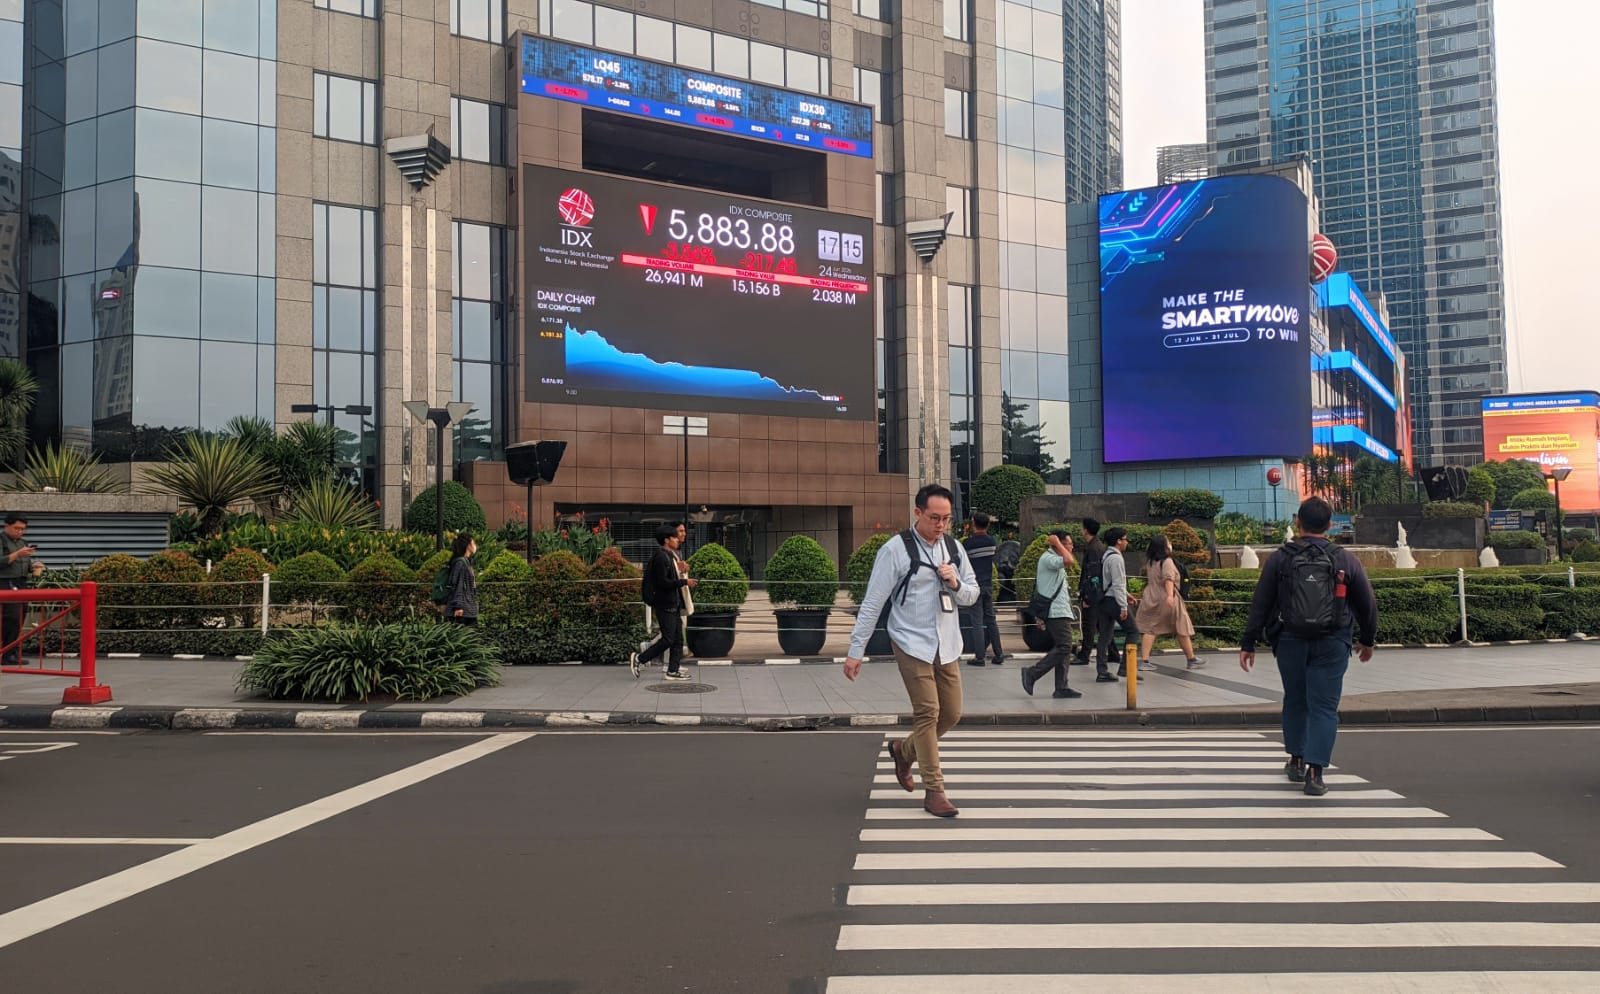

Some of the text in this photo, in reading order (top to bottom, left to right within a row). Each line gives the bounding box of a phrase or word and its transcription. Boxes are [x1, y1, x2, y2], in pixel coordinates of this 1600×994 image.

[594, 58, 620, 74] LQ45
[687, 78, 742, 99] COMPOSITE
[799, 101, 825, 116] IDX30
[729, 205, 793, 223] IDX COMPOSITE
[561, 228, 593, 248] IDX
[668, 208, 795, 255] 5,883.88
[539, 245, 615, 263] Indonesia Stock Exchange
[820, 236, 838, 255] 17
[844, 240, 862, 258] 15
[545, 256, 562, 264] Bursa
[580, 260, 609, 270] Indonesia
[646, 258, 670, 267] TRADING
[645, 268, 703, 288] 26,941 M
[818, 265, 832, 278] 24
[832, 271, 867, 283] Wednesday
[732, 279, 781, 297] 15,156 B
[812, 288, 856, 305] 2.038 M
[537, 290, 596, 306] DAILY CHART
[1162, 289, 1245, 309] MAKE THE
[548, 303, 582, 314] COMPOSITE
[1185, 335, 1201, 343] JUN
[1223, 332, 1240, 340] JUL
[1257, 327, 1276, 340] TO
[1279, 328, 1299, 343] WIN
